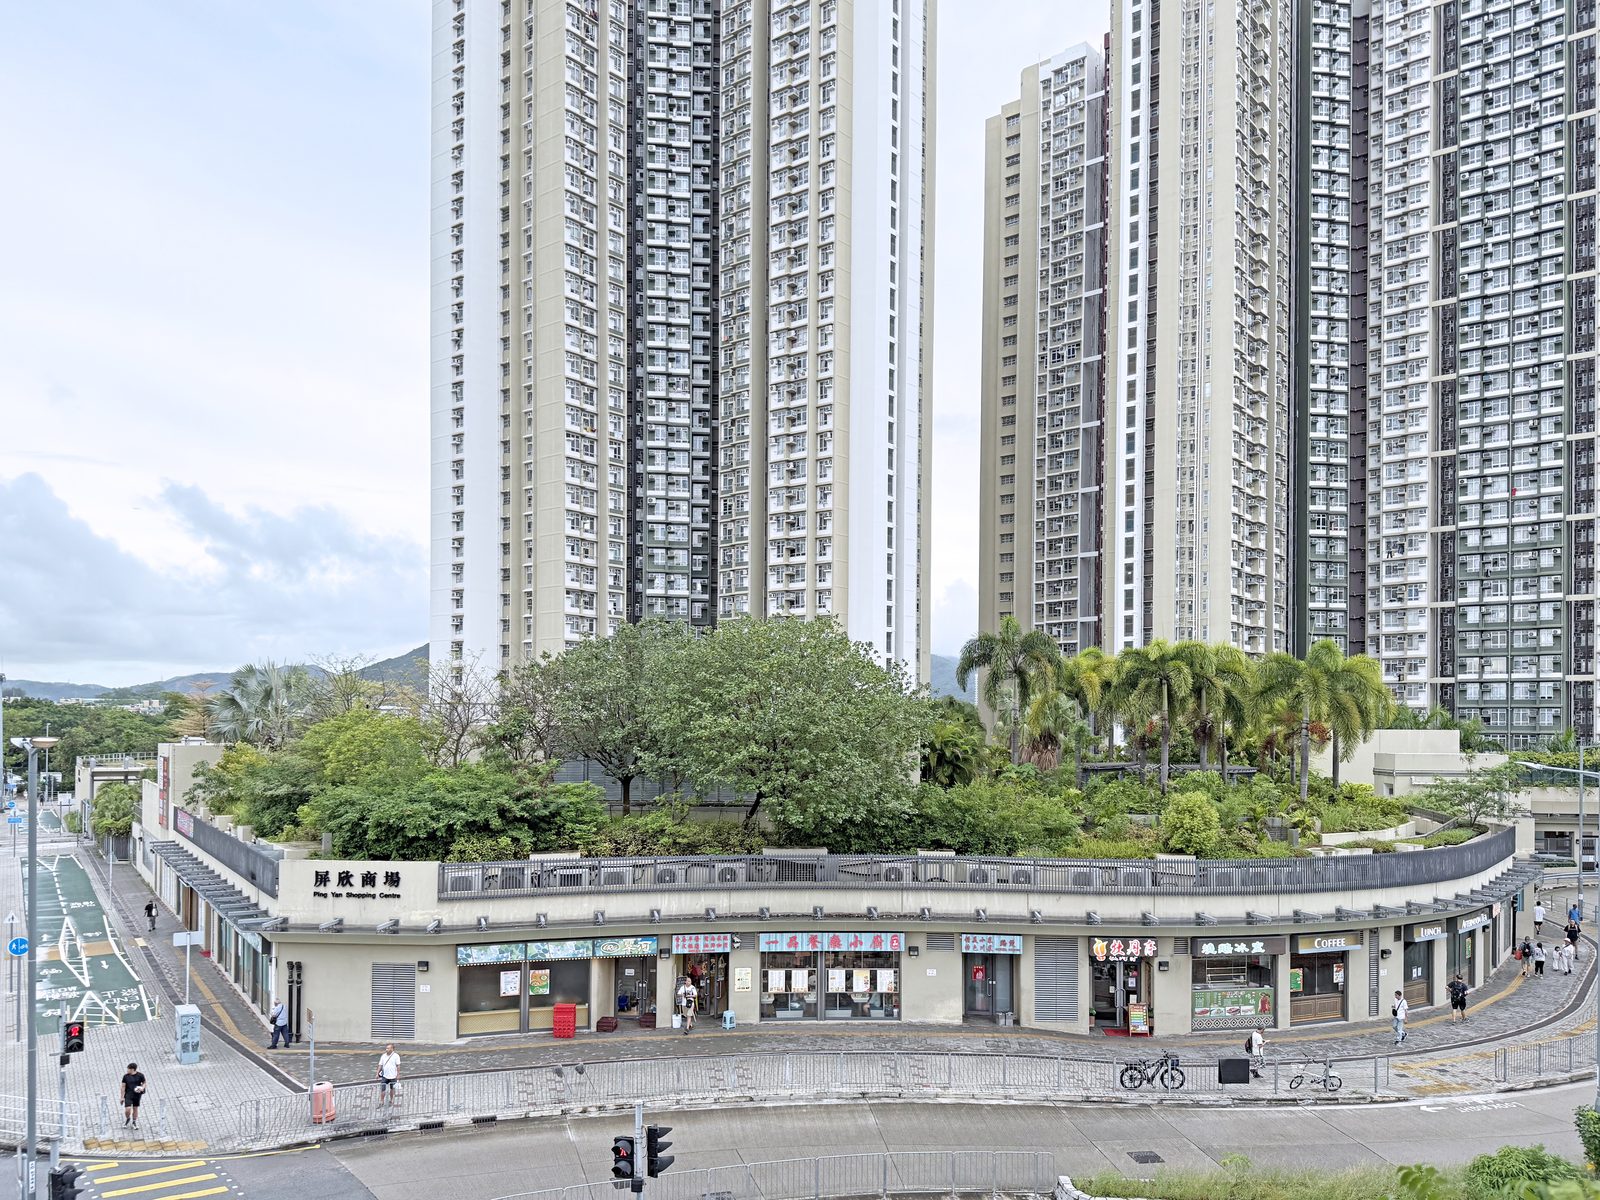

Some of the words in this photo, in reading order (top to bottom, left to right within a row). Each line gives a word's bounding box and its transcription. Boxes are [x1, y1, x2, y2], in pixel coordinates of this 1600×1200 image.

[313, 870, 401, 888] 屏欣商場
[1421, 926, 1442, 937] LUNCH
[1314, 938, 1346, 949] COFFEE
